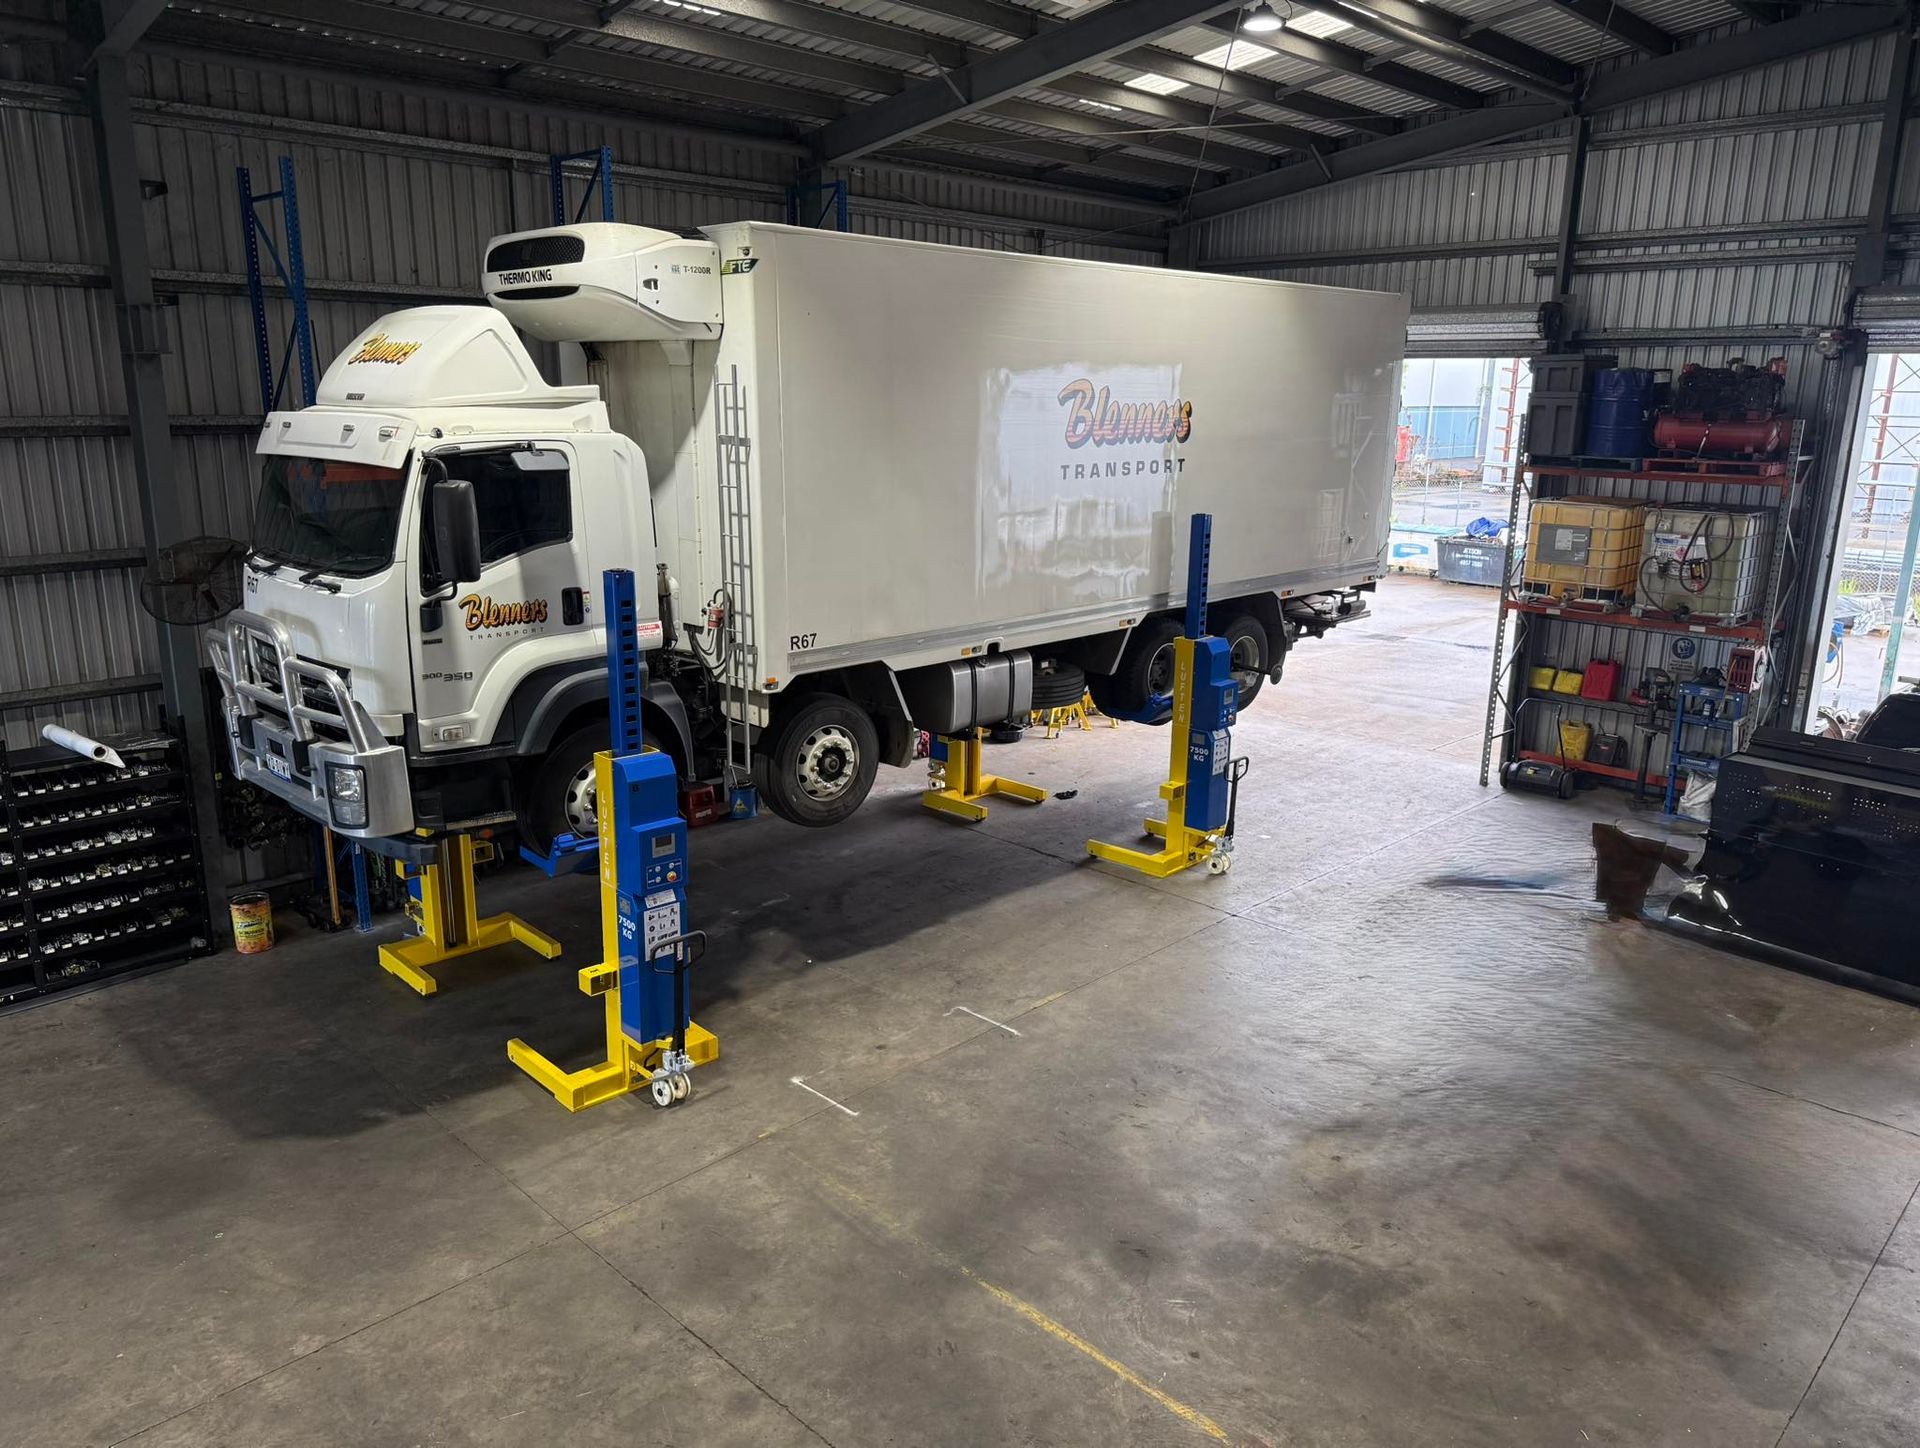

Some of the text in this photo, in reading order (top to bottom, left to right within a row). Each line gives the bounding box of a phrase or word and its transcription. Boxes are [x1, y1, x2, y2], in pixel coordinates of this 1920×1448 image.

[729, 260, 750, 273] FTE
[499, 269, 552, 286] THERMO KING
[1058, 378, 1193, 449] Blenners
[1061, 458, 1186, 480] TRANSPORT
[458, 594, 548, 631] Blenners
[469, 626, 544, 640] TRANSPORT
[790, 633, 817, 651] R67
[1178, 661, 1188, 722] LUFTEN
[1190, 746, 1209, 755] 7500
[1193, 754, 1205, 762] KG
[601, 791, 610, 880] LUFTEN
[618, 915, 636, 932] 7500
[622, 927, 633, 940] KG
